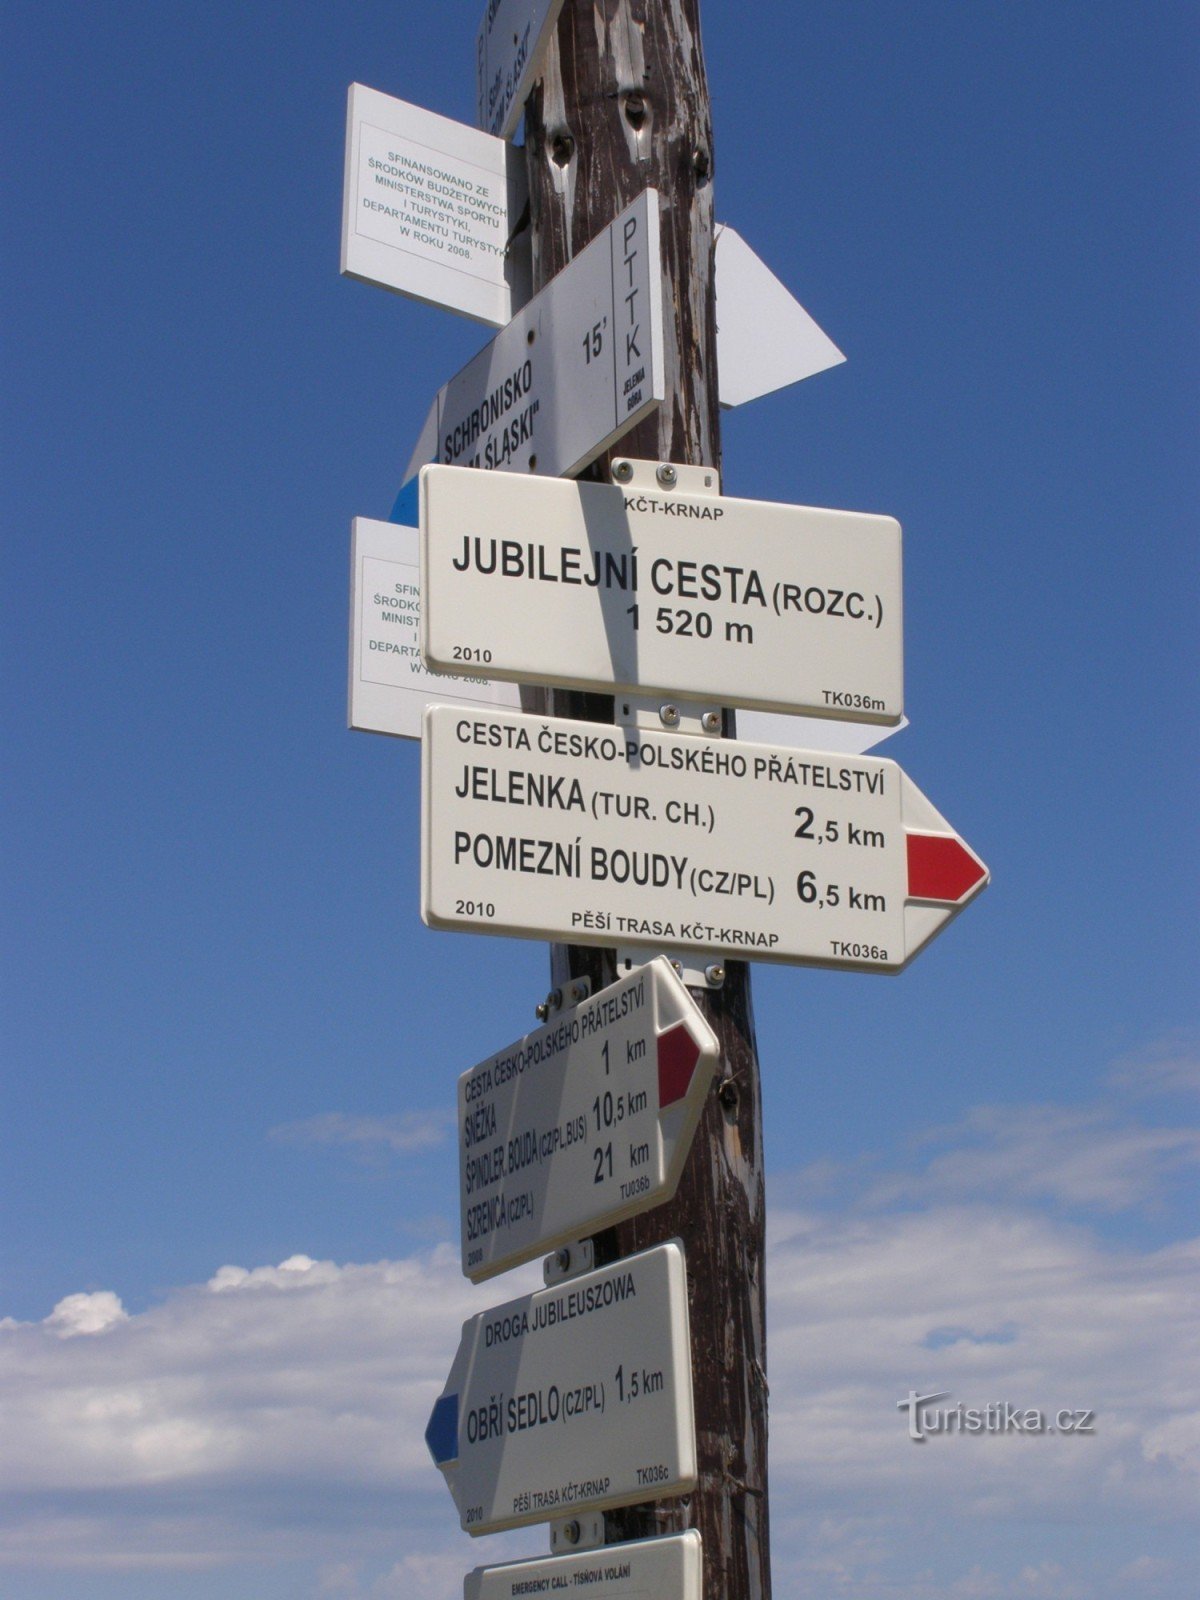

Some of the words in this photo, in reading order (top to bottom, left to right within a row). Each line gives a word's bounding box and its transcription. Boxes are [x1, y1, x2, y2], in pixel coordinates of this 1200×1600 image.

[368, 157, 424, 186] ŚRODKÓW
[428, 179, 507, 218] BUDŻETOWYCH
[388, 151, 473, 191] SFINANSOWANO
[476, 185, 489, 198] ZE
[375, 175, 454, 212] MINISTERSTWA
[457, 205, 500, 229] SPORTU
[411, 201, 471, 233] TURYSTYKI,
[363, 198, 448, 237] DEPARTAMENTU
[453, 231, 507, 258] TURYSTYK
[399, 225, 411, 236] W
[413, 229, 444, 250] ROKU
[447, 243, 473, 260] 2008.
[623, 216, 642, 366] PTTK
[445, 359, 532, 465] SCHRONISKO
[624, 495, 724, 521] KČT-KRNAP
[453, 535, 639, 592] JUBILEJNÍ
[651, 558, 767, 608] CESTA
[773, 582, 884, 629] (ROZC.)
[381, 611, 420, 627] MINIST
[626, 603, 640, 631] 1
[655, 607, 713, 639] 520
[725, 621, 753, 645] m
[369, 639, 421, 658] DEPARTA
[410, 662, 422, 673] W
[453, 646, 492, 663] 2010
[822, 690, 886, 712] TK036m
[456, 720, 532, 751] CESTA
[538, 725, 747, 778] ČESKO-POLSKÉHO
[754, 754, 885, 795] PŘÁTELSTVÍ
[455, 765, 586, 813] JELENKA
[591, 790, 657, 820] (TUR.
[665, 801, 715, 833] CH.)
[794, 806, 839, 845] 2,5
[848, 822, 885, 848] km
[454, 830, 581, 878] POMEZNÍ
[591, 846, 688, 890] BOUDY
[690, 867, 775, 905] (CZ/PL)
[796, 870, 840, 910] 6,5
[849, 886, 886, 912] km
[455, 900, 495, 918] 2010
[571, 910, 611, 930] PĚŠÍ
[616, 917, 675, 937] TRASA
[680, 922, 780, 947] KČT-KRNAP
[830, 940, 888, 960] TK036a
[465, 1071, 493, 1103] CESTA
[494, 1020, 580, 1086] ČESKO-POLSKÉHO
[582, 976, 645, 1038] PŘÁTELSTVÍ
[465, 1100, 497, 1148] SNĚŽKA
[601, 1040, 610, 1075] 1
[627, 1038, 646, 1064] km
[508, 1128, 538, 1174] BOUDA
[593, 1091, 624, 1132] 10,5
[627, 1090, 647, 1117] km
[467, 1193, 507, 1241] SZRENICA
[593, 1141, 613, 1184] 21
[630, 1142, 649, 1168] km
[485, 1312, 529, 1348] DROGA
[532, 1272, 636, 1332] JUBILEUSZOWA
[467, 1393, 504, 1444] OBŘÍ
[507, 1385, 560, 1433] SEDLO
[562, 1381, 605, 1424] (CZ/PL)
[615, 1364, 638, 1404] 1,5
[642, 1368, 664, 1394] km
[513, 1492, 531, 1513] PĚŠÍ
[533, 1487, 560, 1509] TRASA
[562, 1477, 610, 1502] KČT-KRNAP
[637, 1465, 669, 1486] TK036c
[466, 1508, 483, 1523] 2010
[511, 1580, 550, 1596] EMERGENCY
[551, 1576, 568, 1589] CALL
